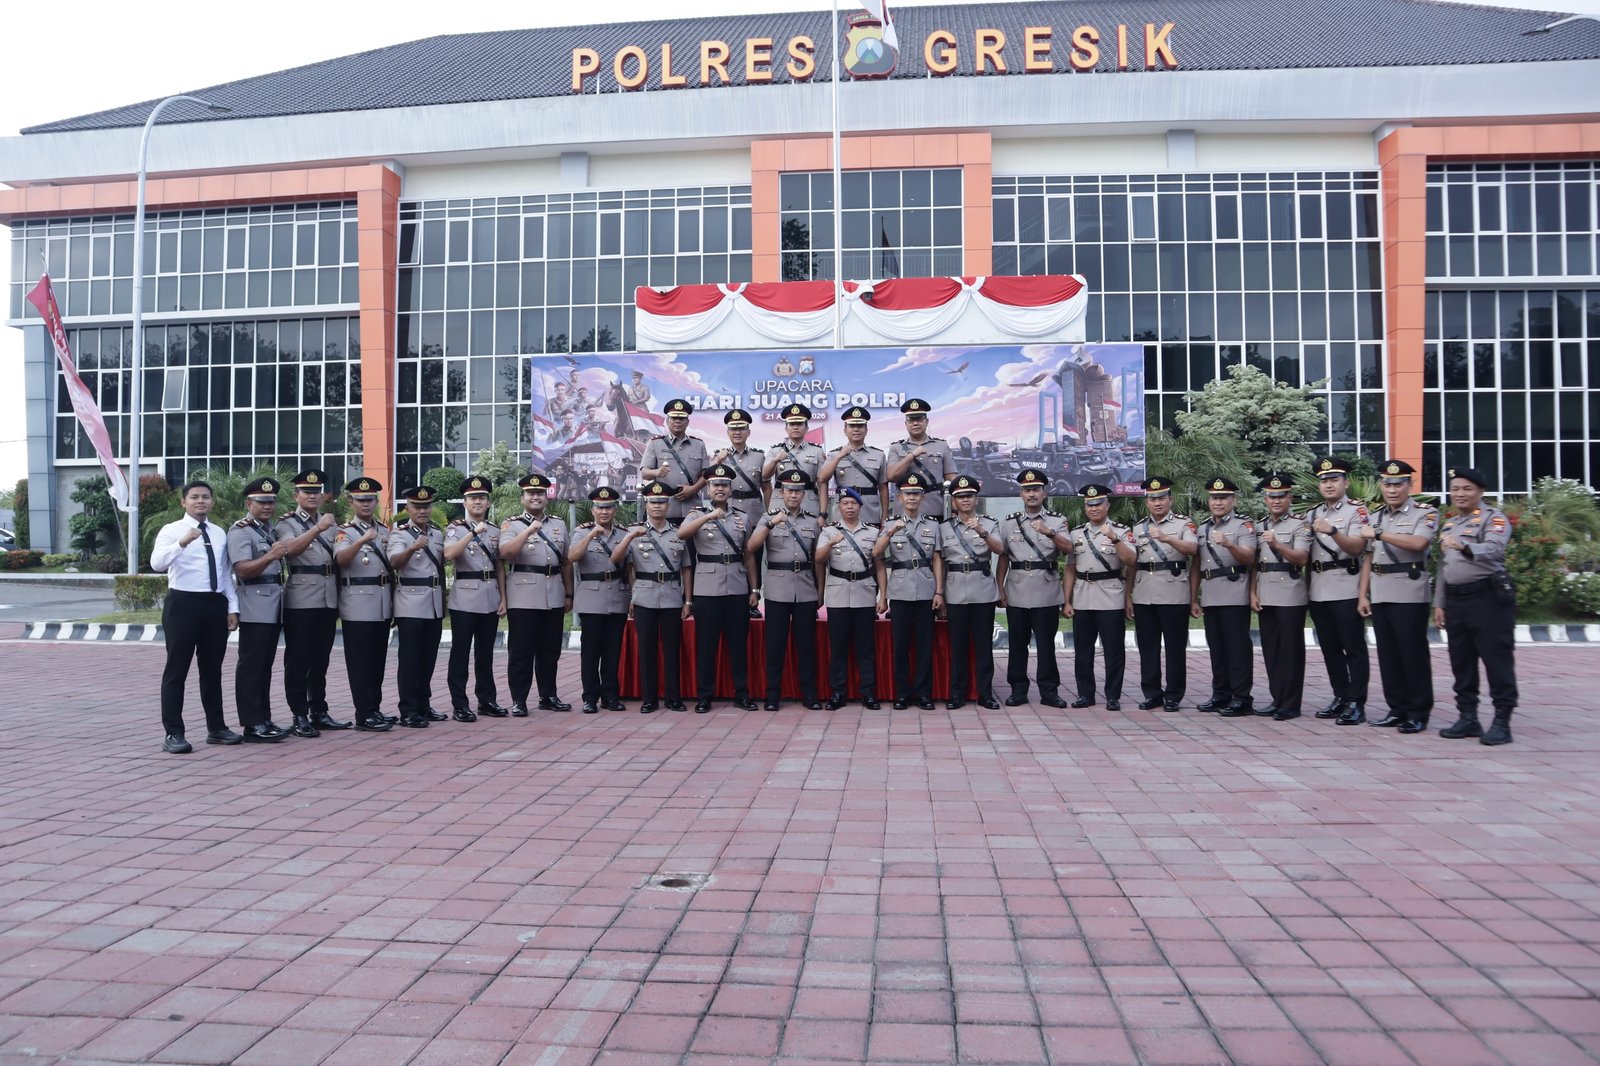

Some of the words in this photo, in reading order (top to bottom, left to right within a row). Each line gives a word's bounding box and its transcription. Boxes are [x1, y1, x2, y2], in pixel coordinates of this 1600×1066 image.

[571, 35, 816, 92] POLRES
[924, 22, 1179, 76] GRESIK
[755, 379, 834, 393] UPACARA
[685, 395, 741, 410] HARI
[748, 393, 828, 410] JUANG
[836, 392, 906, 409] POLRI
[810, 412, 826, 420] 026
